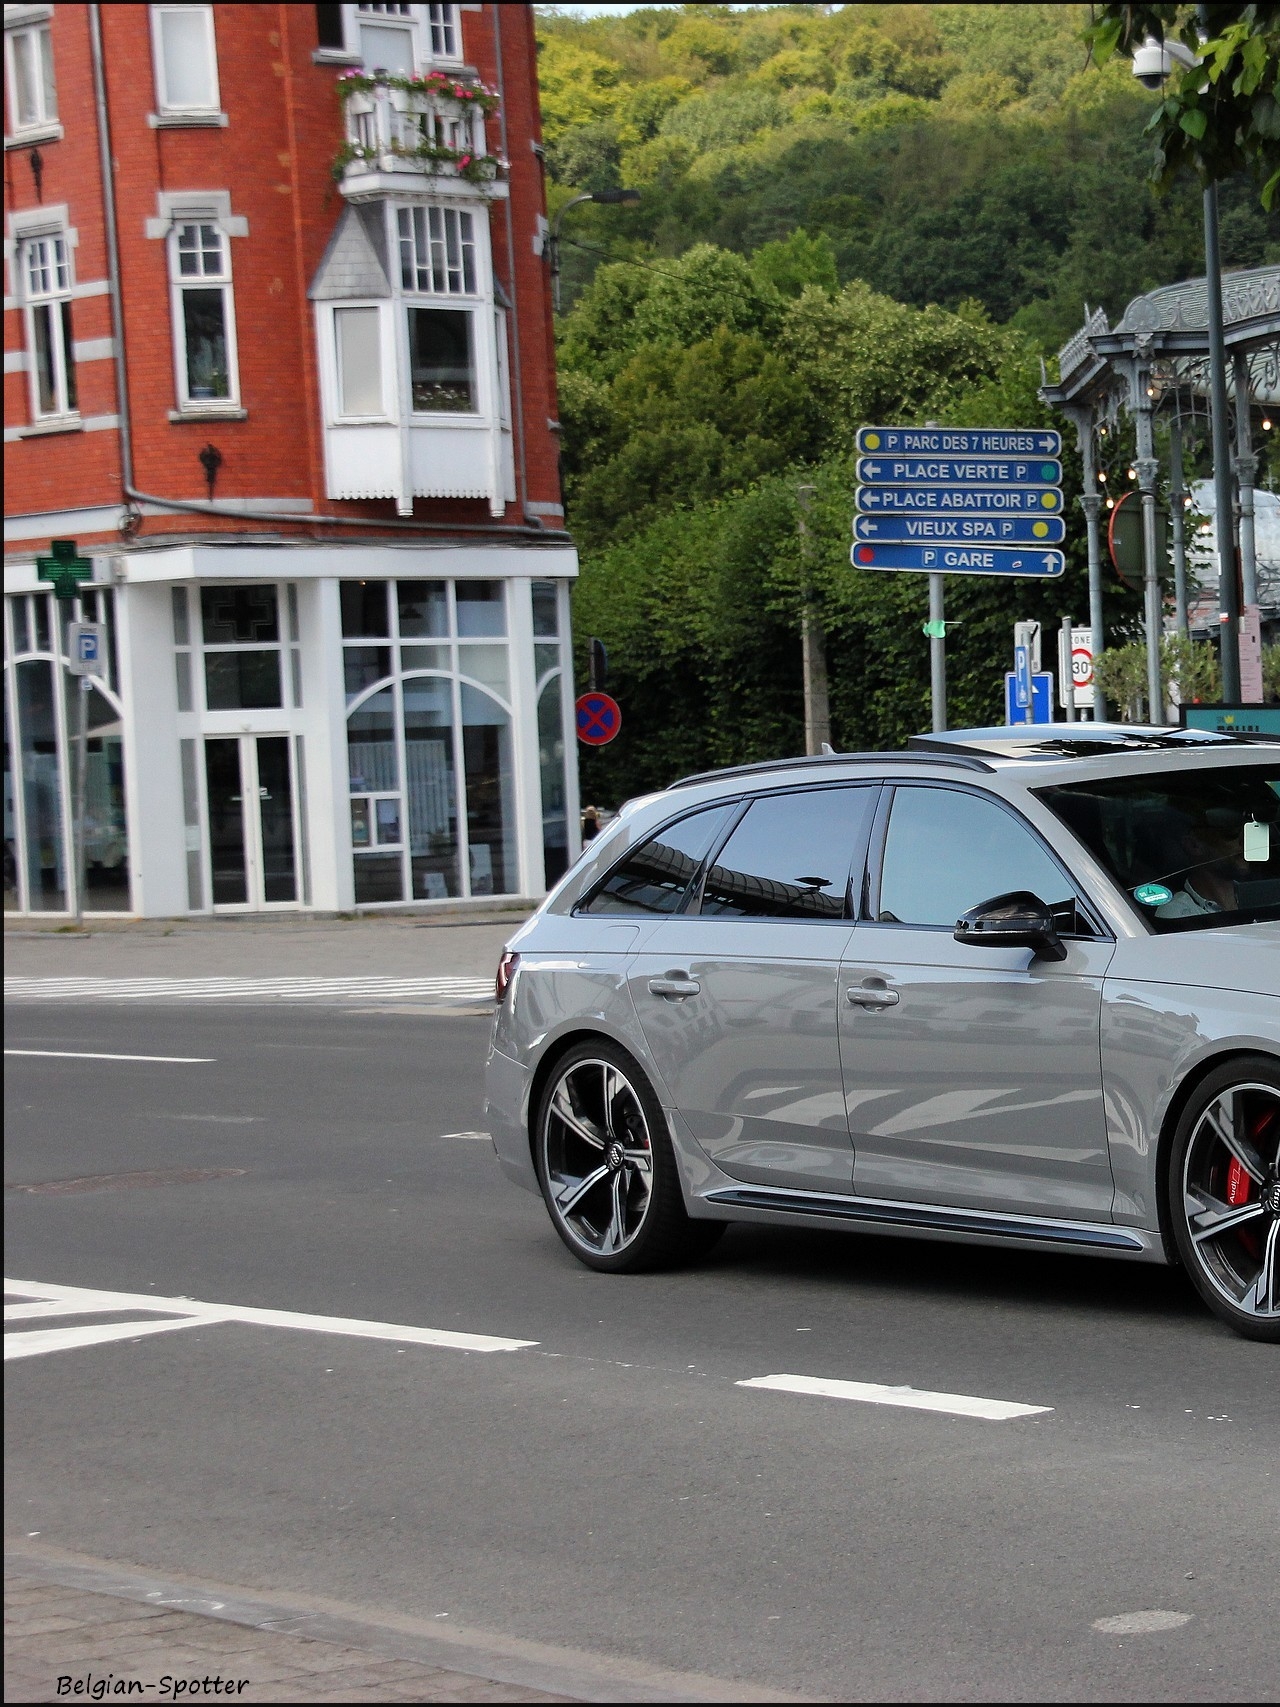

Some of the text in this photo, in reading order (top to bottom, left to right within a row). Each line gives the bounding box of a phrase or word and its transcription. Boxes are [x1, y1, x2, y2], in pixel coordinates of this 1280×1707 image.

[888, 435, 1034, 451] P PARC DES 7 HEURES
[894, 464, 1026, 479] PLACE VERTE P
[883, 493, 1037, 508] PLACE ABATTOIR P
[906, 521, 1013, 536] VIEUX SPA P
[924, 552, 994, 567] P GARE
[1071, 635, 1091, 645] ONE
[81, 639, 95, 659] P
[1017, 650, 1026, 682] P
[1072, 661, 1089, 675] 30
